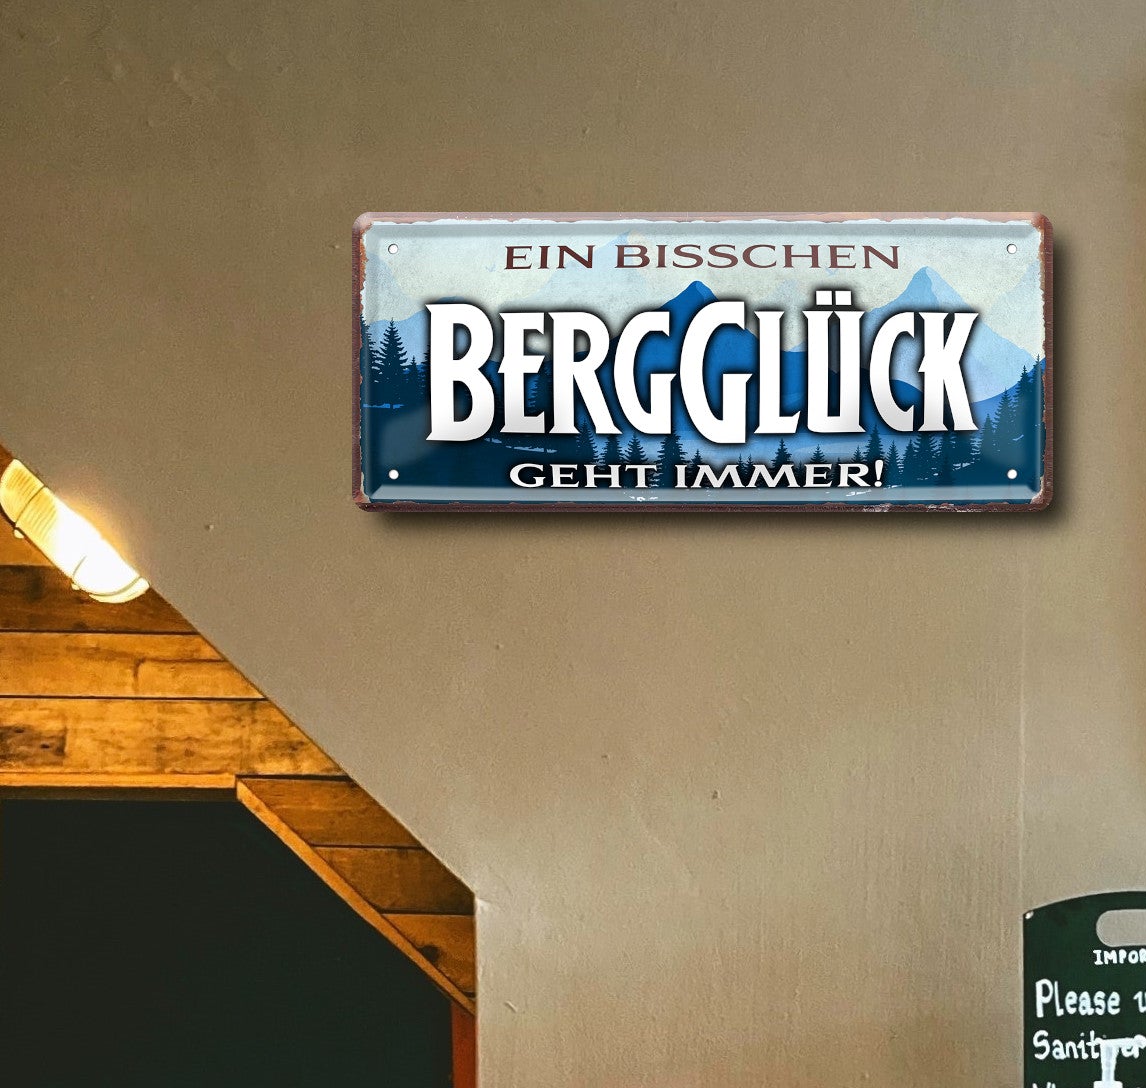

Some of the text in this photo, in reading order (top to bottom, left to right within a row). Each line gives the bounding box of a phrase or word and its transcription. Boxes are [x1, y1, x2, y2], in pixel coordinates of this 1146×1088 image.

[503, 243, 900, 270] EIN BISSCHEN
[509, 460, 885, 488] GEHT IMMER!
[1035, 978, 1121, 1018] Please
